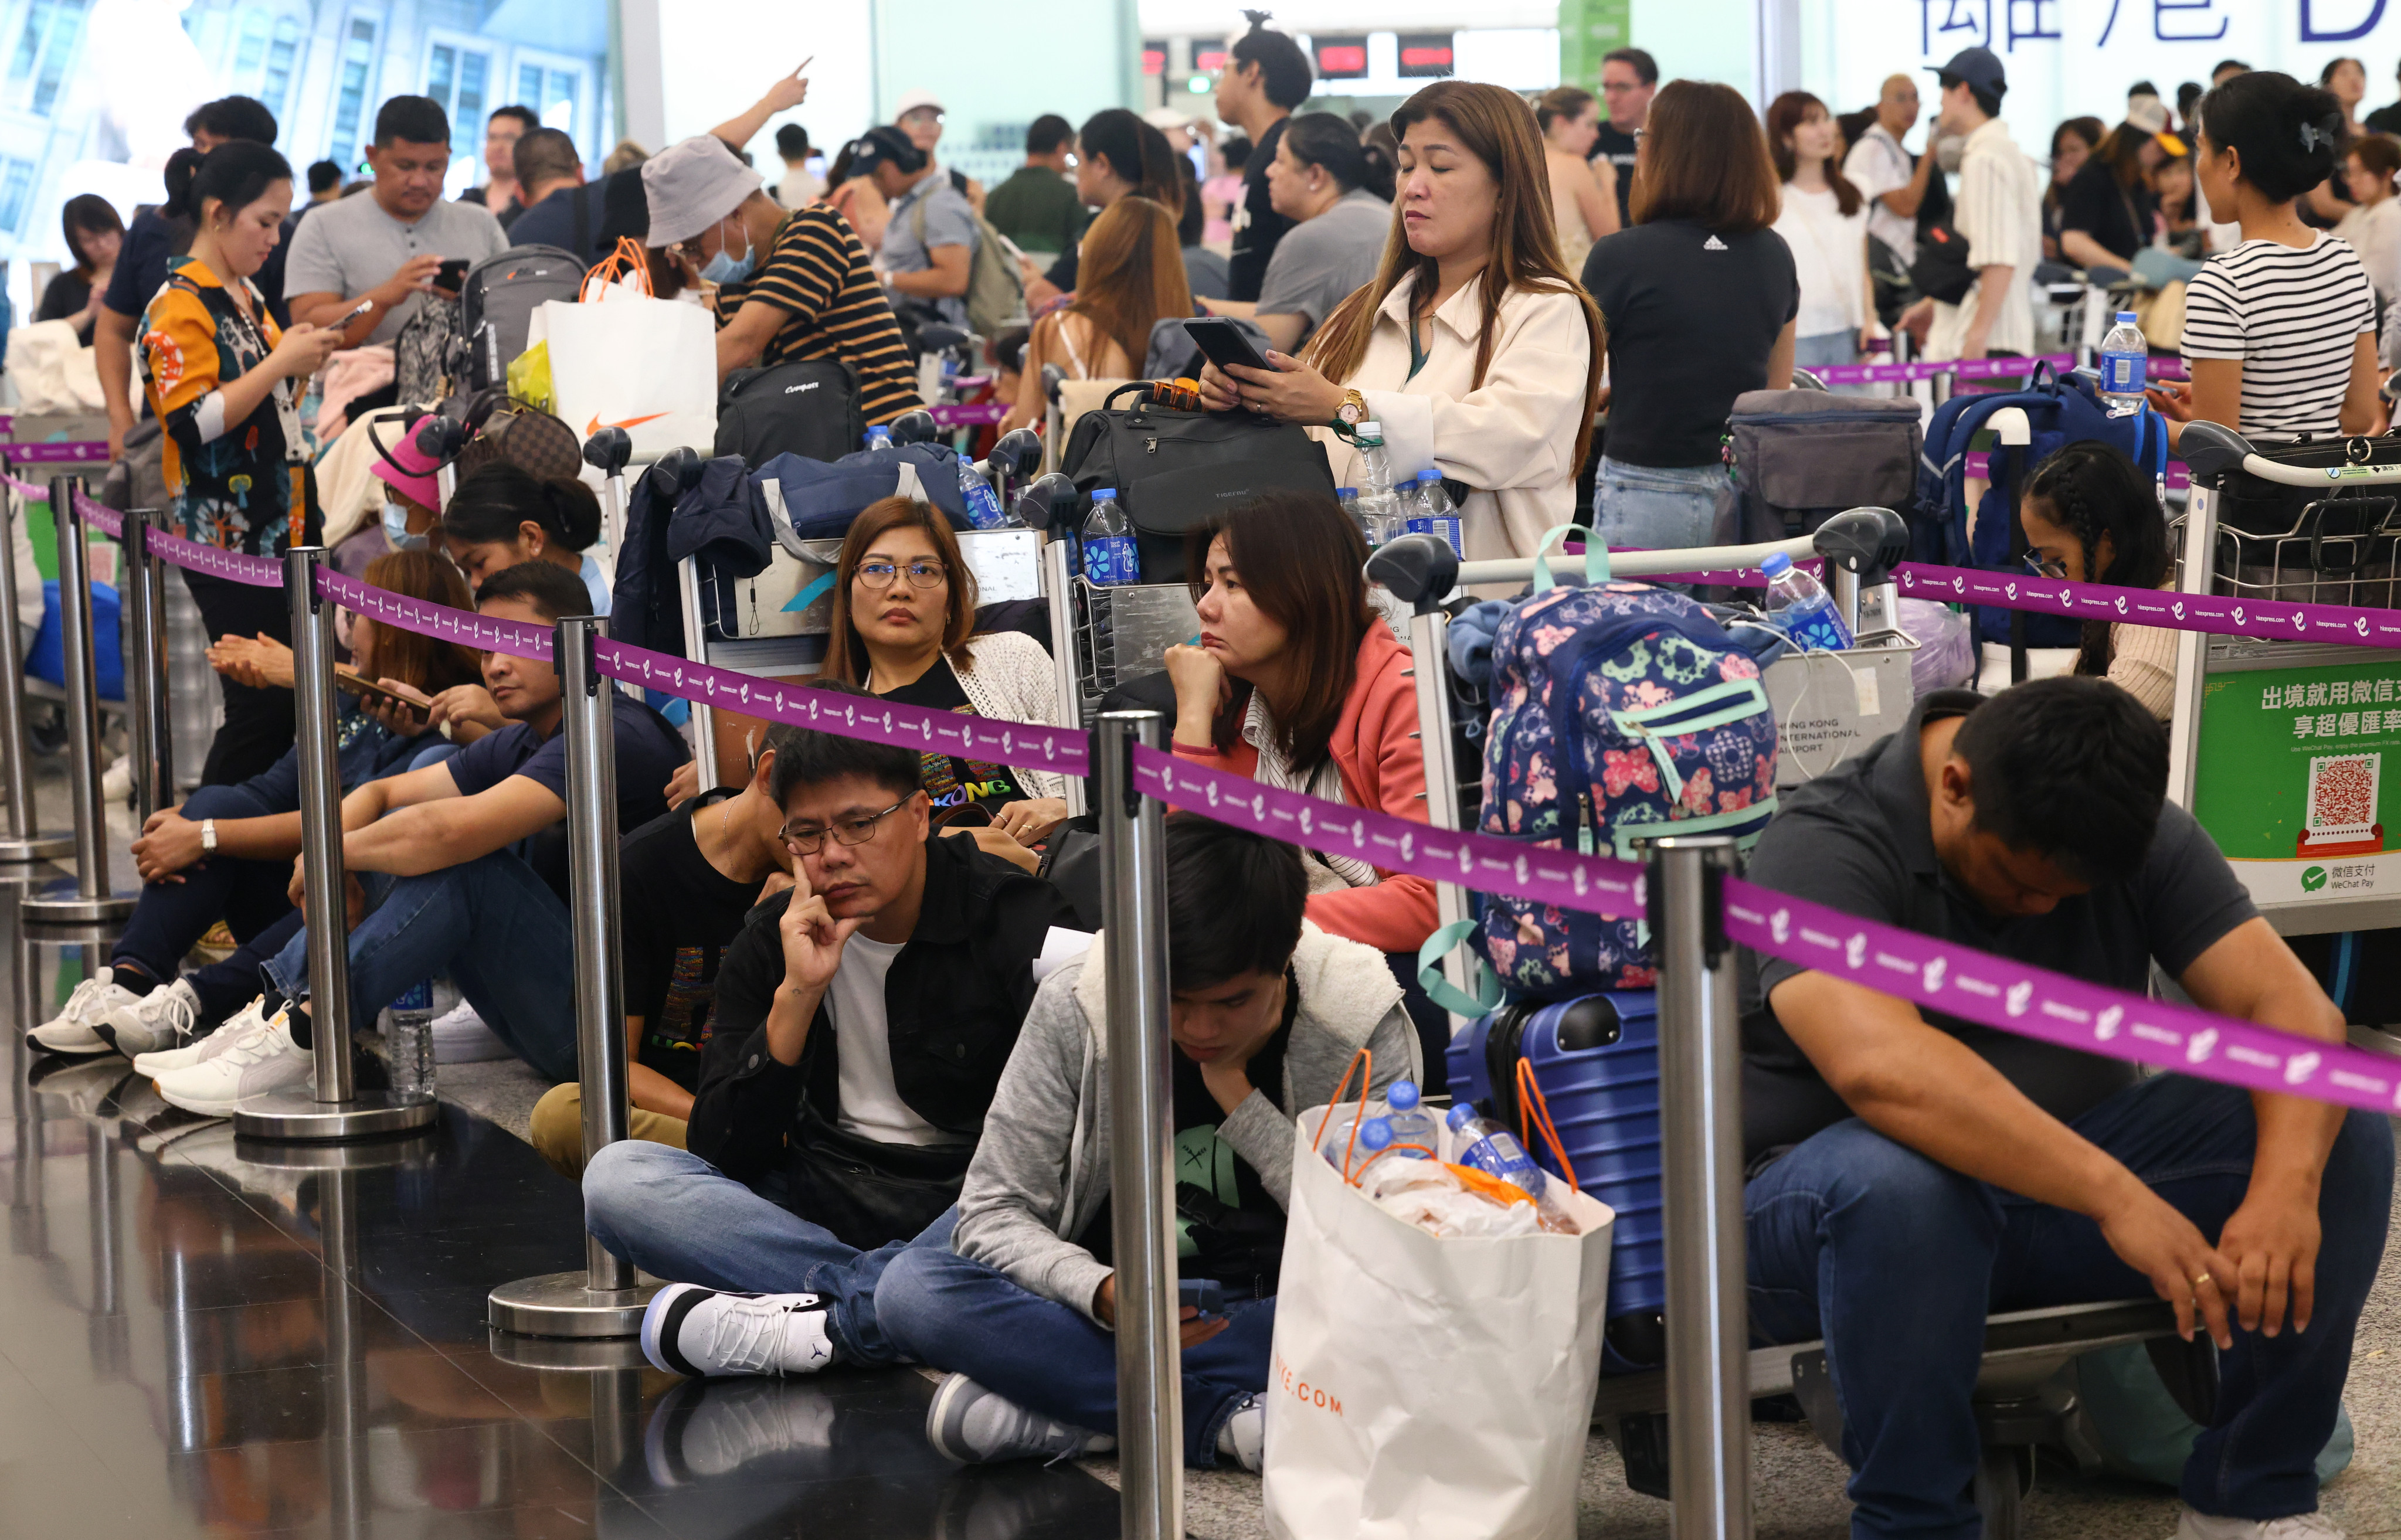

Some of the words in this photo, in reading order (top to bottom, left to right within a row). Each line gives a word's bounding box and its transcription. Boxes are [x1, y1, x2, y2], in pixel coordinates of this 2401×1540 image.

[1974, 584, 2000, 593] hkexpress.com
[2026, 590, 2054, 599] hkexpress.com
[2081, 597, 2109, 606] hkexpress.com
[2137, 604, 2165, 613] hkexpress.com
[2195, 610, 2225, 618] hkexpress.com
[2256, 614, 2285, 623] hkexpress.com
[2316, 620, 2347, 628] hkexpress.com
[1809, 719, 1839, 728] KONG
[2293, 709, 2401, 739] 享超優匯率
[1780, 730, 1861, 742] NTERNATIONAL
[933, 780, 1011, 807] KONG
[2332, 864, 2375, 879] 微信支付
[2331, 881, 2359, 889] WeChat
[2362, 879, 2374, 889] Pay
